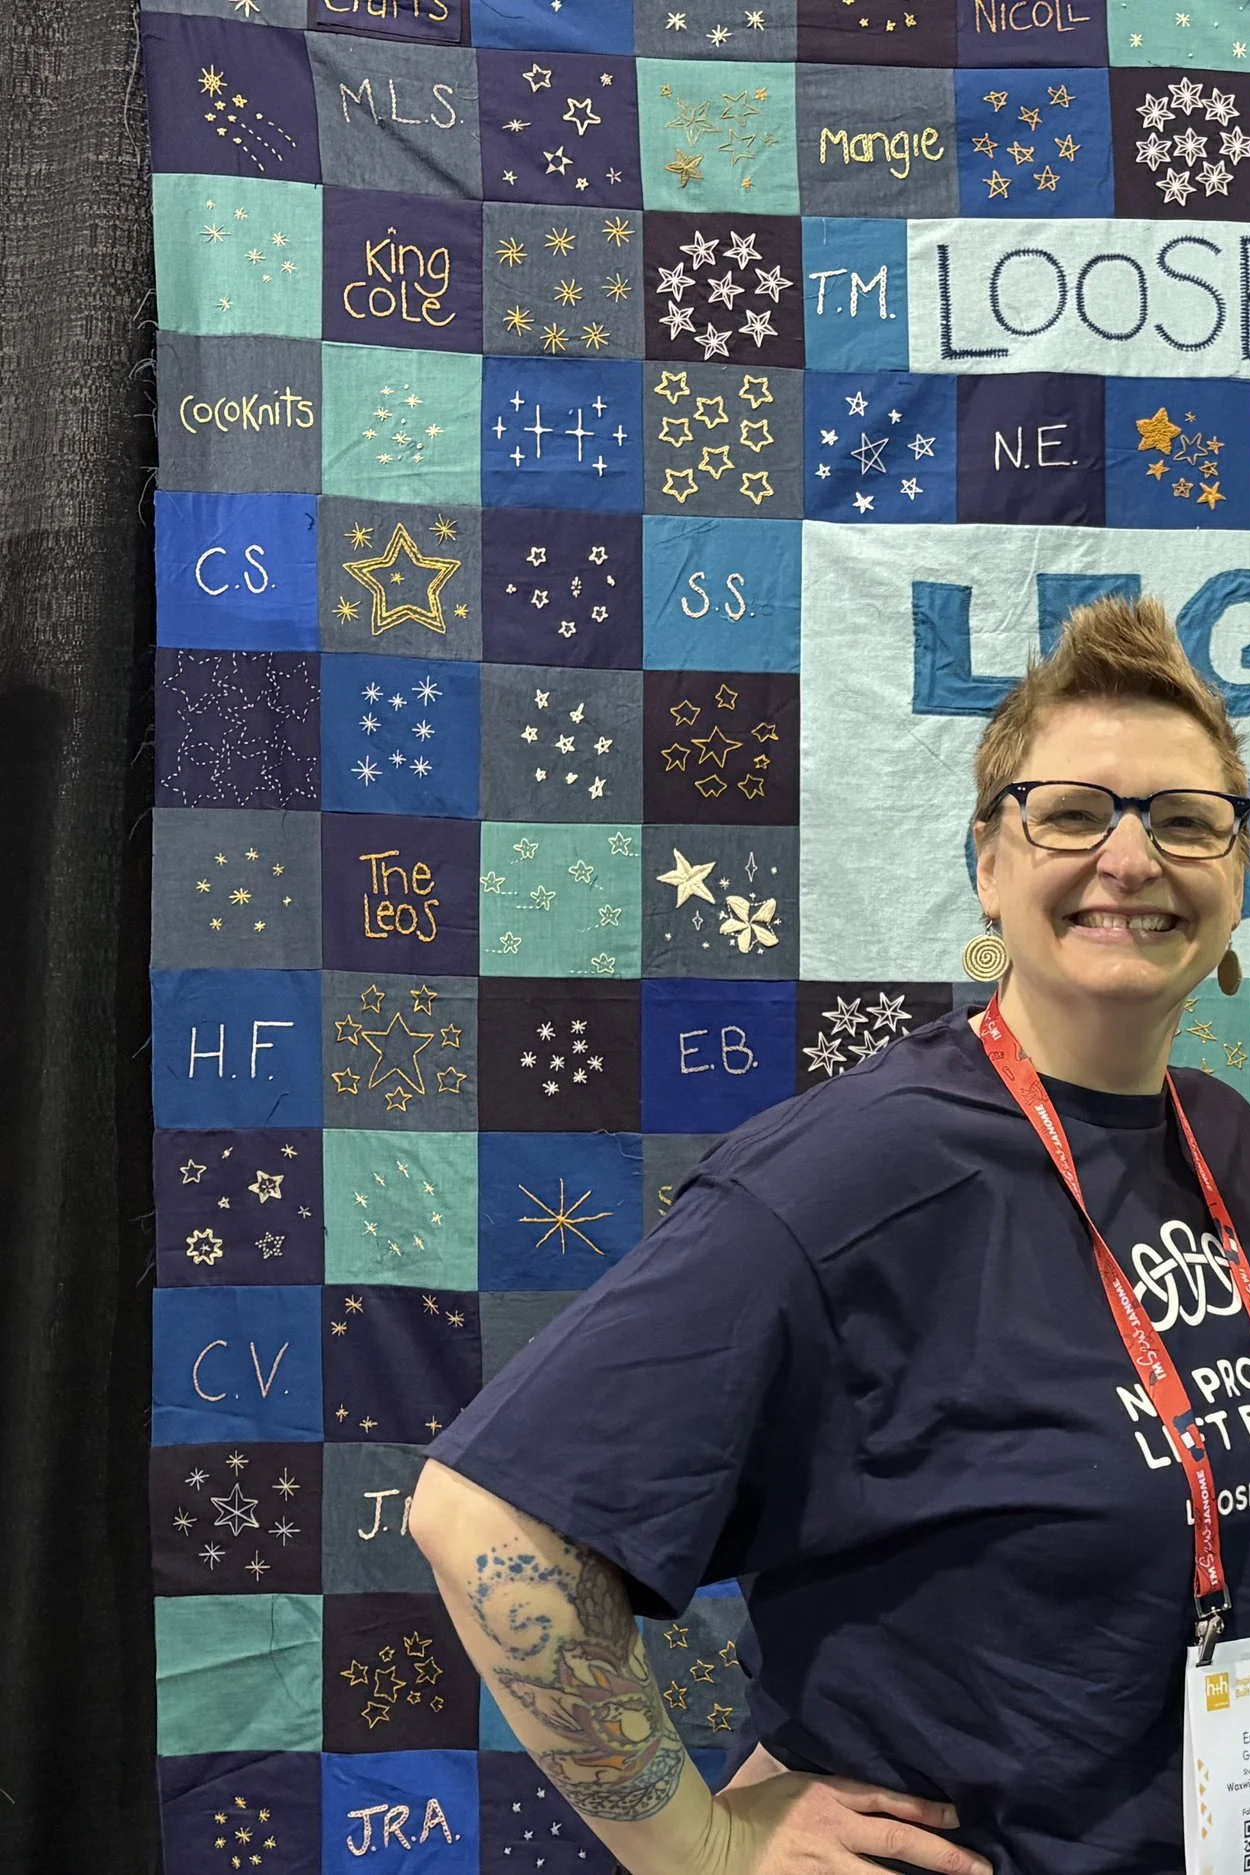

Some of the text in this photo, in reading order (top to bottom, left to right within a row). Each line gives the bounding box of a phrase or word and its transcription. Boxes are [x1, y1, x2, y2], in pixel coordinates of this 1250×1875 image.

[339, 79, 464, 129] M.L.S.
[818, 126, 945, 181] Mangie
[365, 238, 450, 298] King
[808, 265, 896, 319] T.M.
[993, 423, 1079, 472] N.E.
[195, 543, 276, 596] C.S.
[681, 571, 755, 621] S.S.
[359, 850, 435, 895] The
[189, 1020, 294, 1081] H.F.
[679, 1025, 759, 1075] E.B.
[1112, 1276, 1141, 1326] JANOME
[192, 1339, 290, 1402] C.V.
[1135, 1410, 1231, 1469] LT
[1196, 1469, 1211, 1525] JANOME
[347, 1798, 461, 1856] J.R.A.
